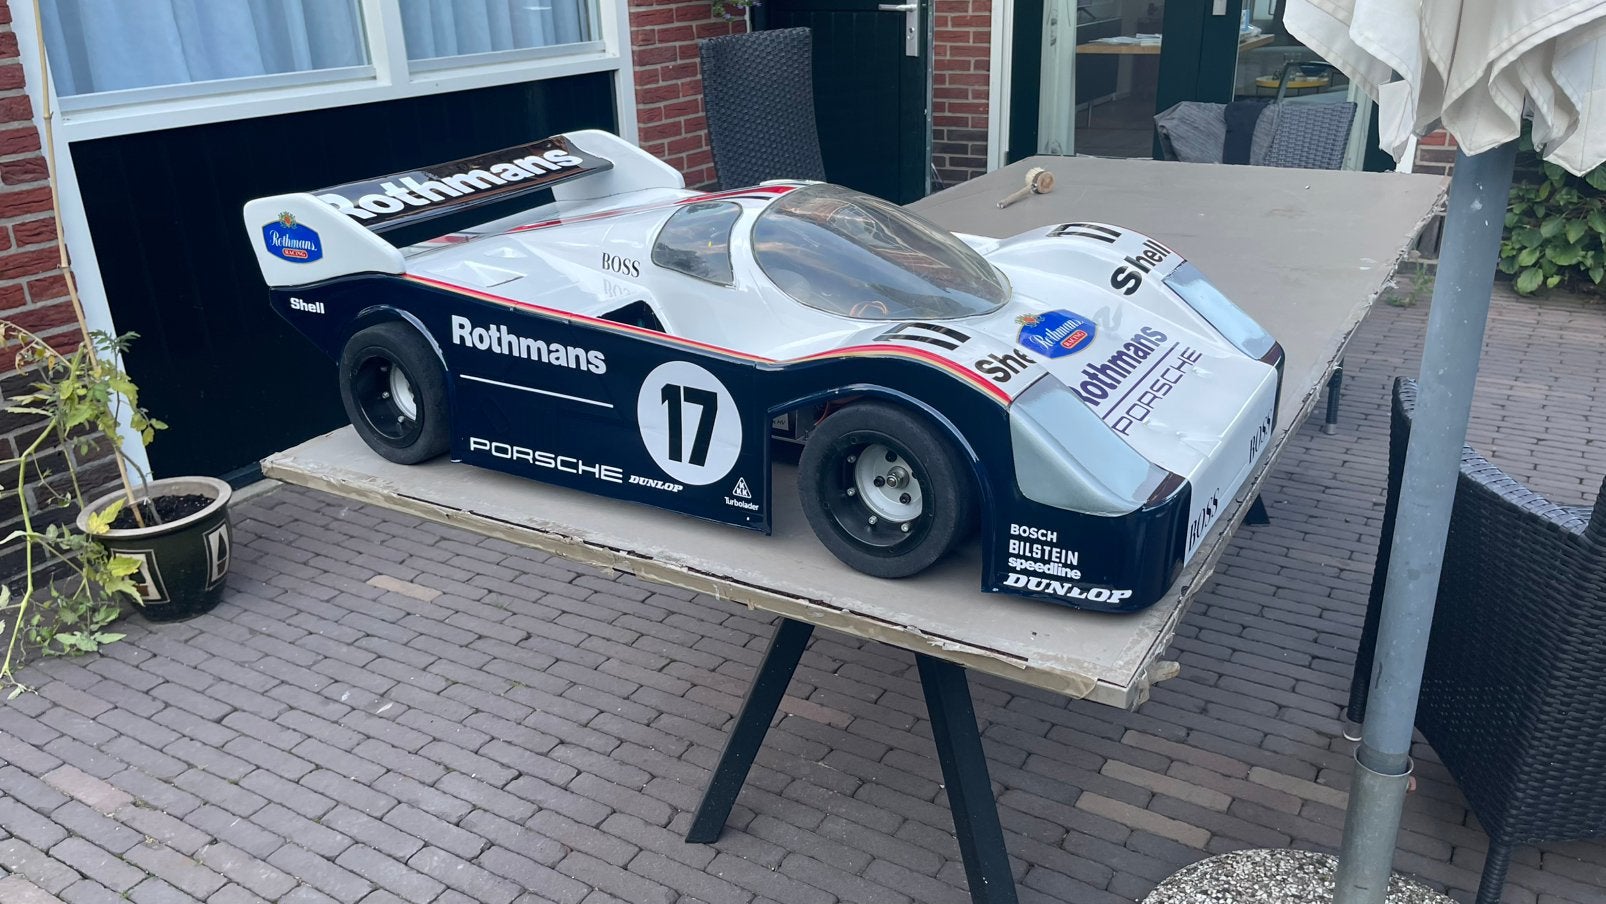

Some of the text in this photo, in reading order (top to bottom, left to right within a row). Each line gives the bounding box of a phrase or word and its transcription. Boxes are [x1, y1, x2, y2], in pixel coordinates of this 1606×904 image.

[317, 149, 584, 220] Rothmans
[269, 229, 318, 252] Rothmans
[1046, 223, 1122, 243] 17
[602, 252, 641, 278] BOSS
[1110, 239, 1171, 295] Shell
[290, 297, 325, 314] Shell
[451, 314, 607, 375] Rothmans
[872, 322, 972, 351] 17
[1029, 319, 1085, 350] Rothmans
[974, 348, 1038, 383] She
[1111, 346, 1203, 436] PORSCHE
[661, 383, 718, 467] 17
[469, 437, 624, 483] PORSCHE
[628, 475, 684, 493] DUNLOP
[724, 496, 759, 511] Turbolader
[1010, 523, 1057, 543] BOSCH
[1188, 487, 1220, 551] BOSS
[1009, 539, 1079, 566] BILSTEIN
[1008, 557, 1082, 580] speedline
[1003, 573, 1133, 604] DUNLOP
